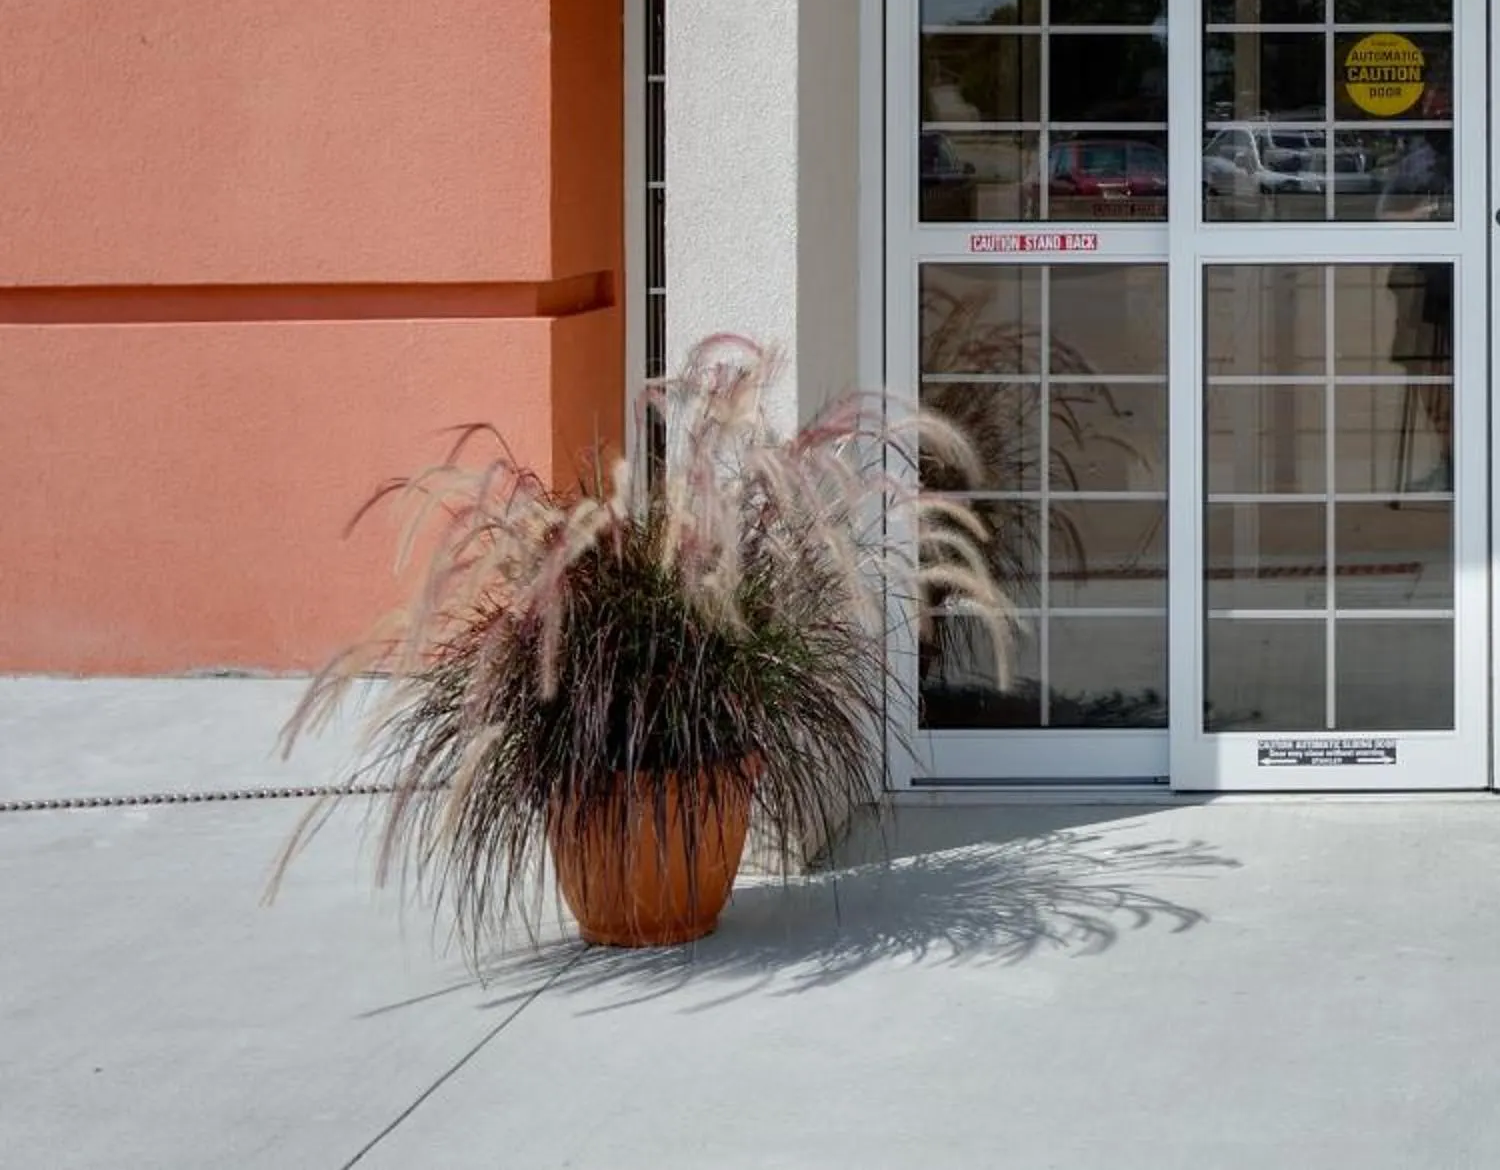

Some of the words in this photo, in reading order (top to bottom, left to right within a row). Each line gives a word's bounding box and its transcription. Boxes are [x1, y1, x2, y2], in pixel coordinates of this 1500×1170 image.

[1351, 50, 1420, 61] AUTOMATIC
[1347, 67, 1421, 81] CAUTION
[1369, 86, 1402, 98] DOOR
[973, 235, 1019, 250] CAUTION
[1025, 235, 1060, 250] STAND
[1065, 235, 1096, 249] BACK
